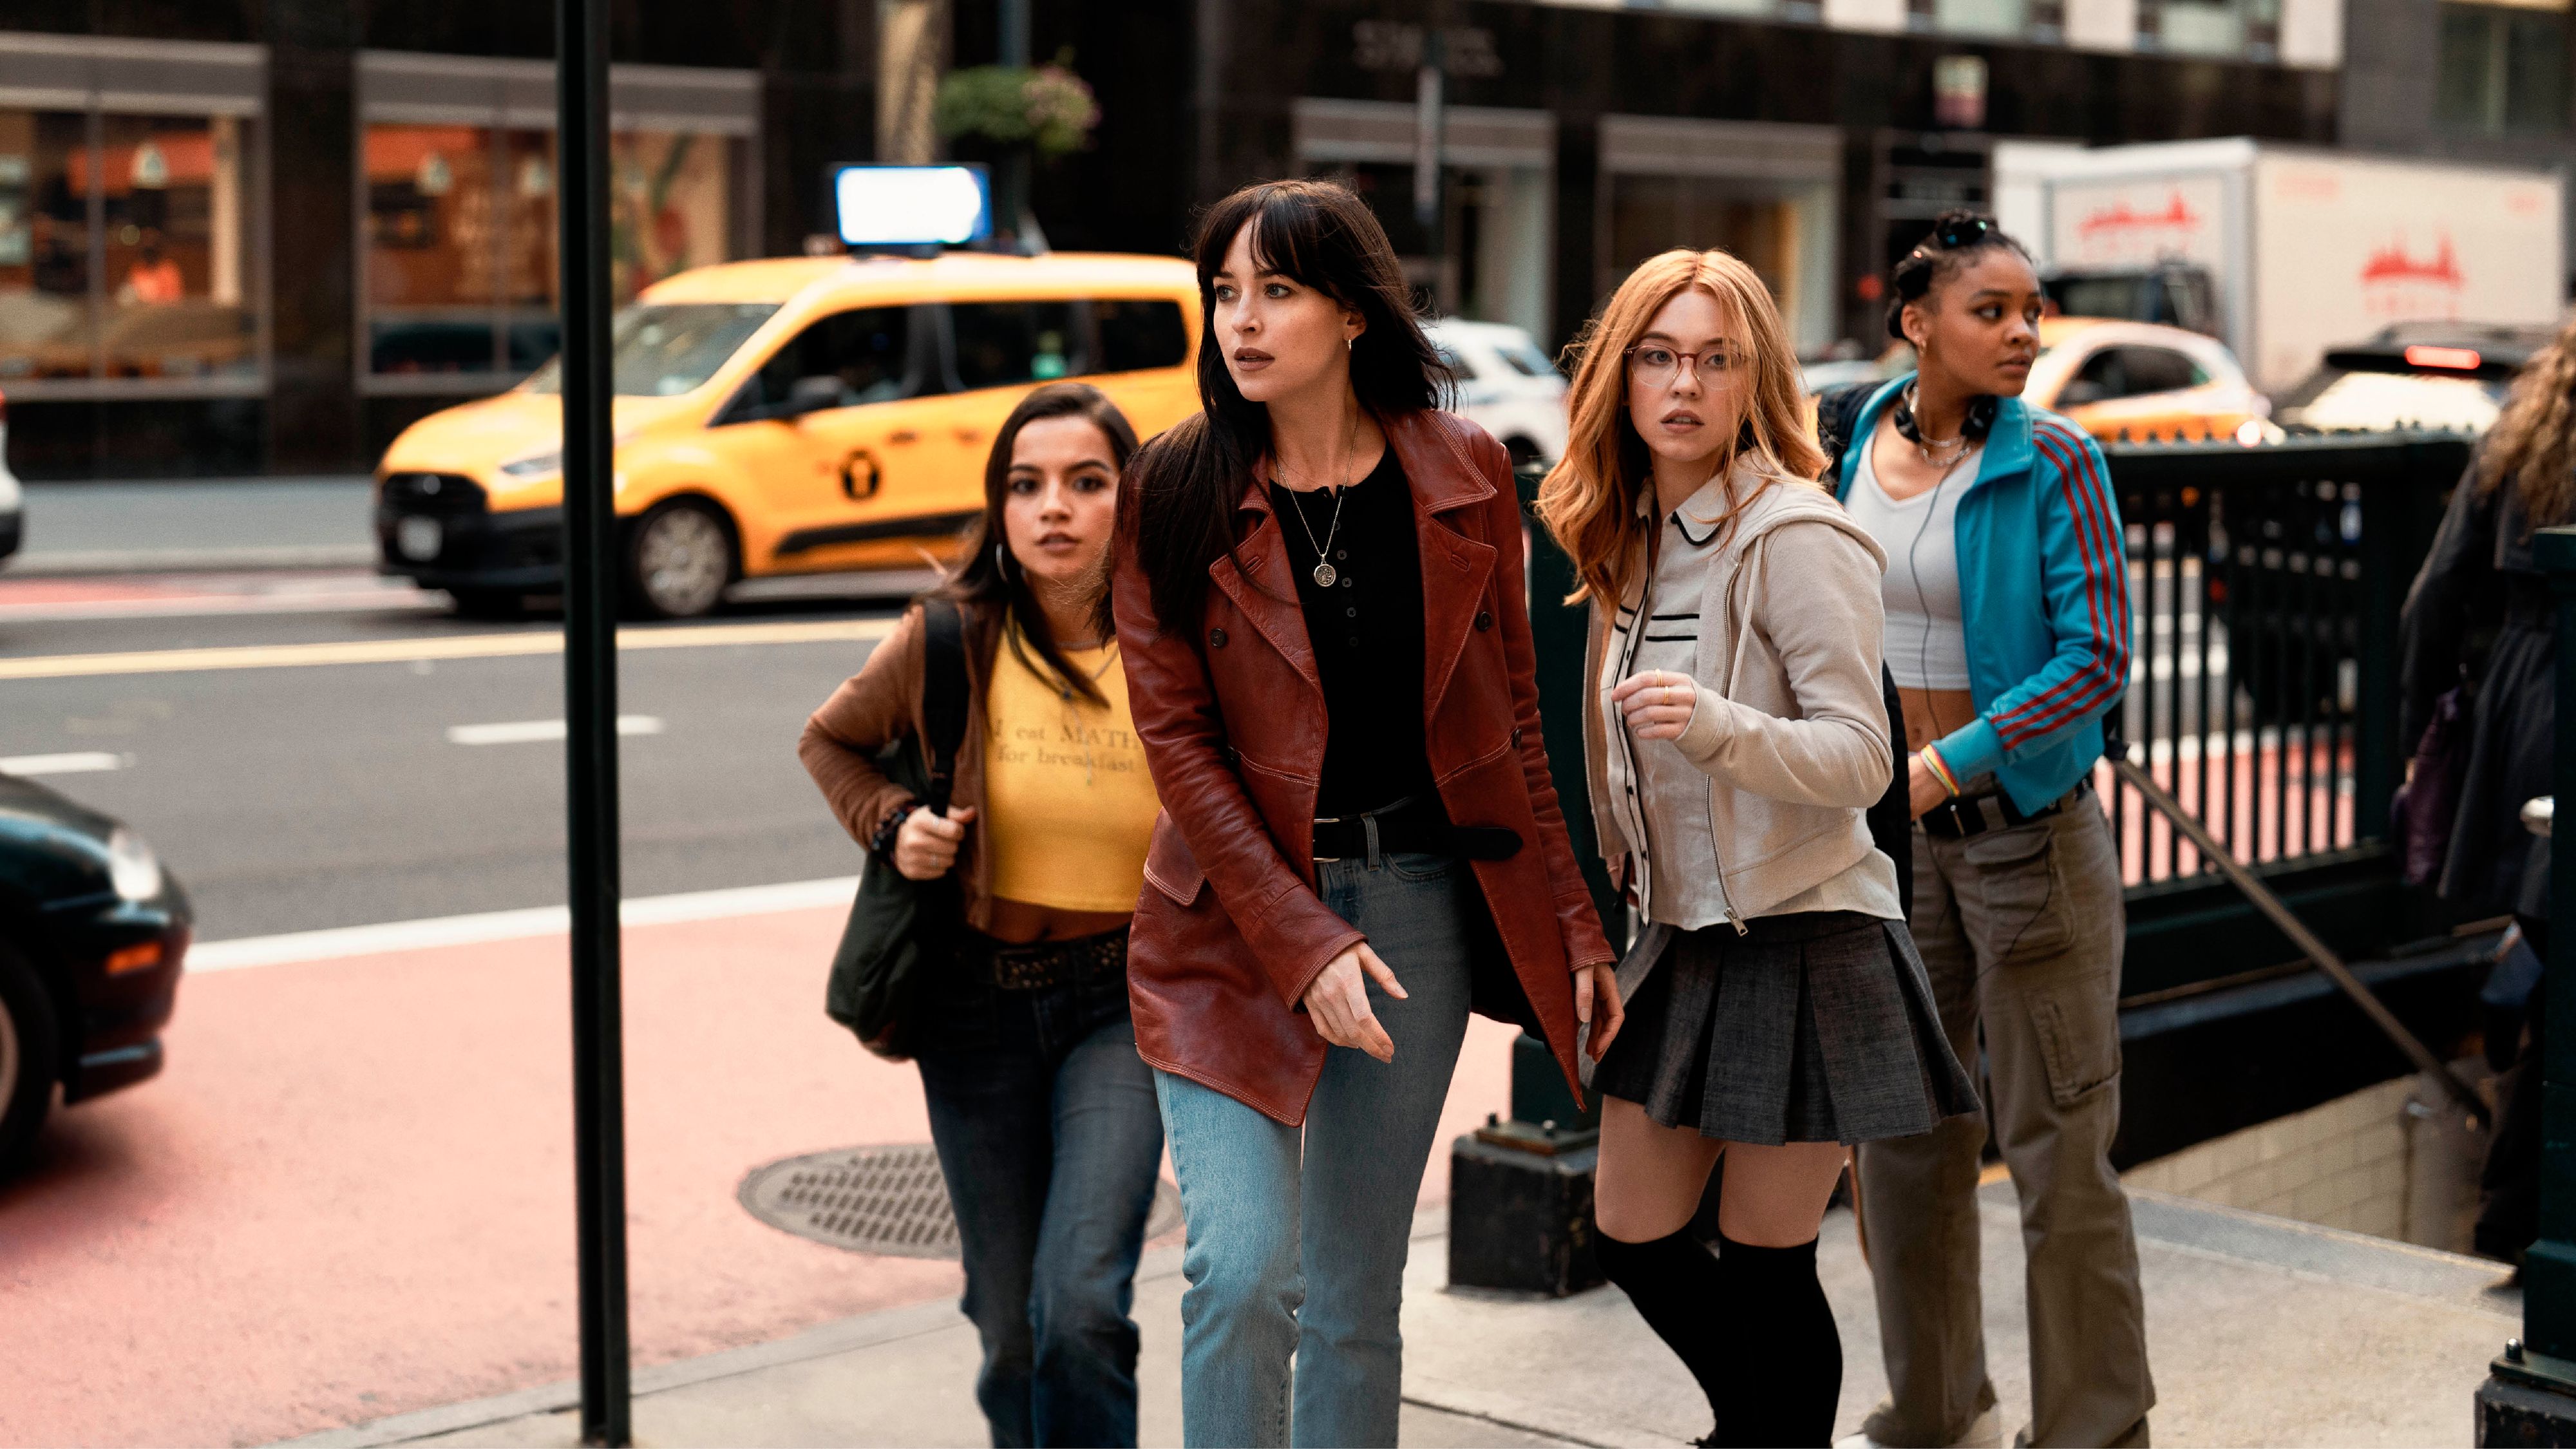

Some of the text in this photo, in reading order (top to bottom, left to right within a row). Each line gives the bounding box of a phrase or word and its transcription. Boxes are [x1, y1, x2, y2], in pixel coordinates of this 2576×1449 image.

[1016, 726, 1045, 740] eat
[998, 744, 1133, 772] for breakfast
